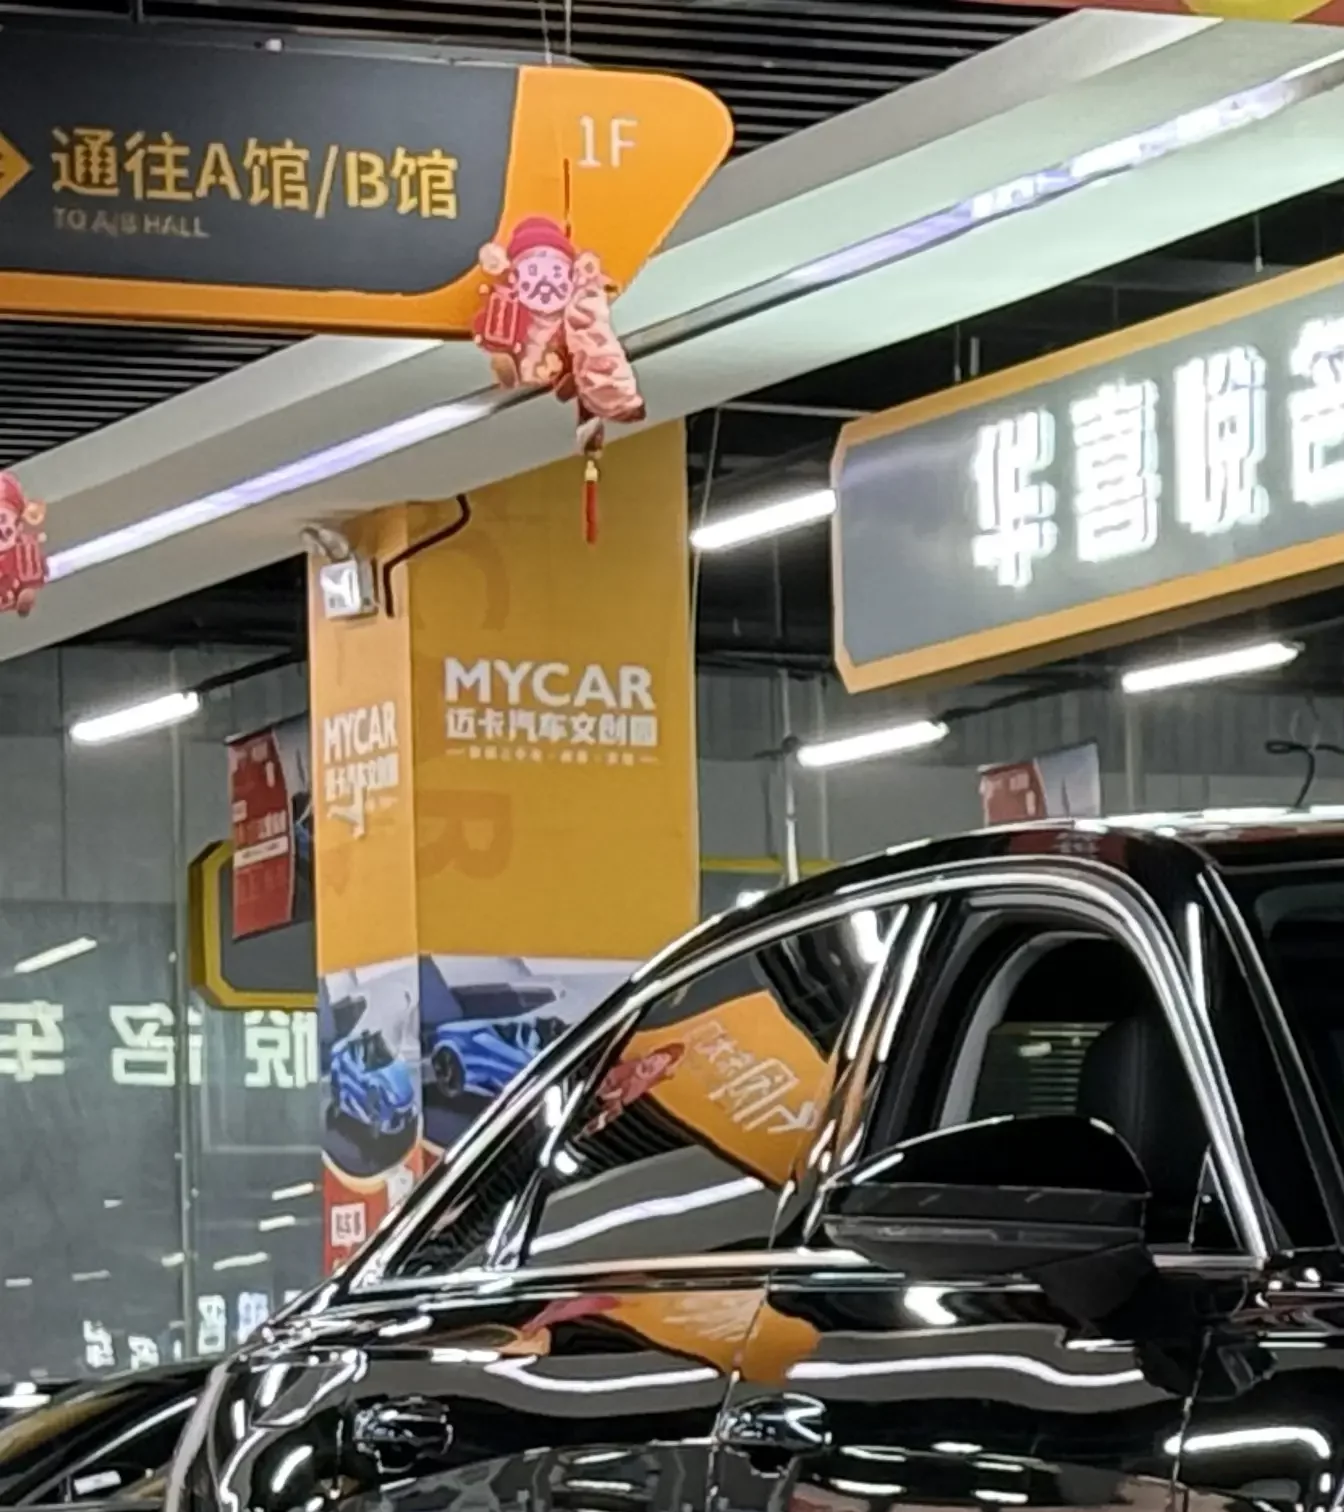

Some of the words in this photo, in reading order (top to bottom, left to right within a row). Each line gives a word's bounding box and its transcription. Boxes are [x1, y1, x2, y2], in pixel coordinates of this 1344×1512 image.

[577, 115, 639, 169] 1F
[51, 126, 459, 219] 通往A馆/B馆
[143, 216, 211, 238] HALL
[445, 657, 656, 710] MYCAR
[323, 701, 398, 765] MYCAR
